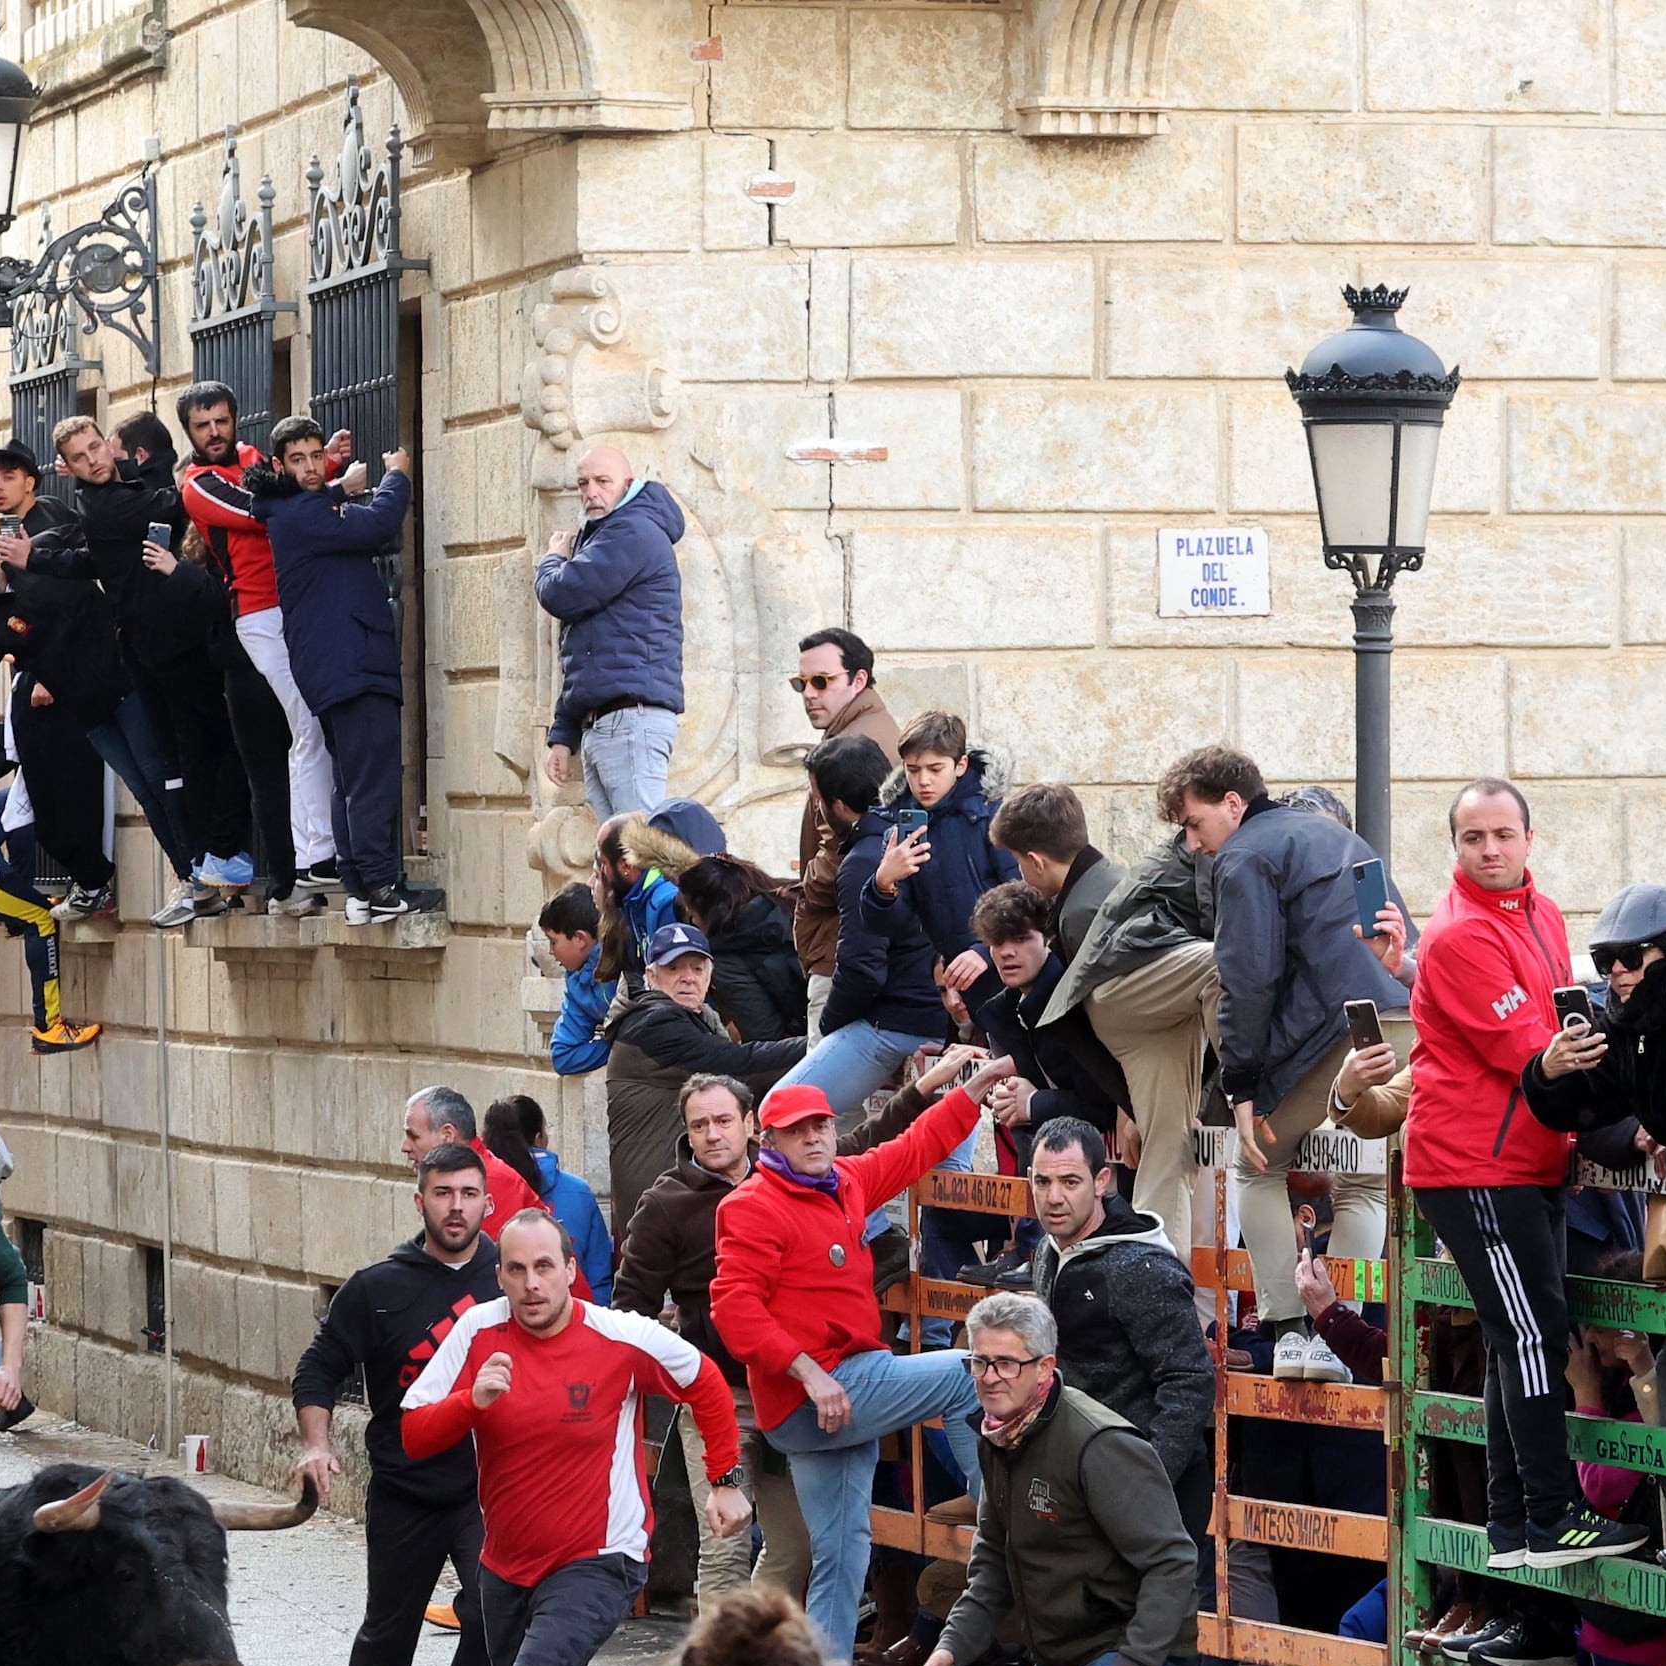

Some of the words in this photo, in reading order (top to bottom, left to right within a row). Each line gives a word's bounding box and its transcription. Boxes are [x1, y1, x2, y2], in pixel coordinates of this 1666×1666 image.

[1176, 536, 1254, 557] PLAZUELA
[1202, 562, 1229, 582] DEL
[1190, 587, 1245, 608] CONDE.
[1491, 983, 1529, 1021] HH
[999, 1182, 1013, 1210] 27
[1596, 1429, 1665, 1470] GESFISA
[1243, 1504, 1295, 1544] MATEOS
[1428, 1526, 1482, 1571] CAMPO
